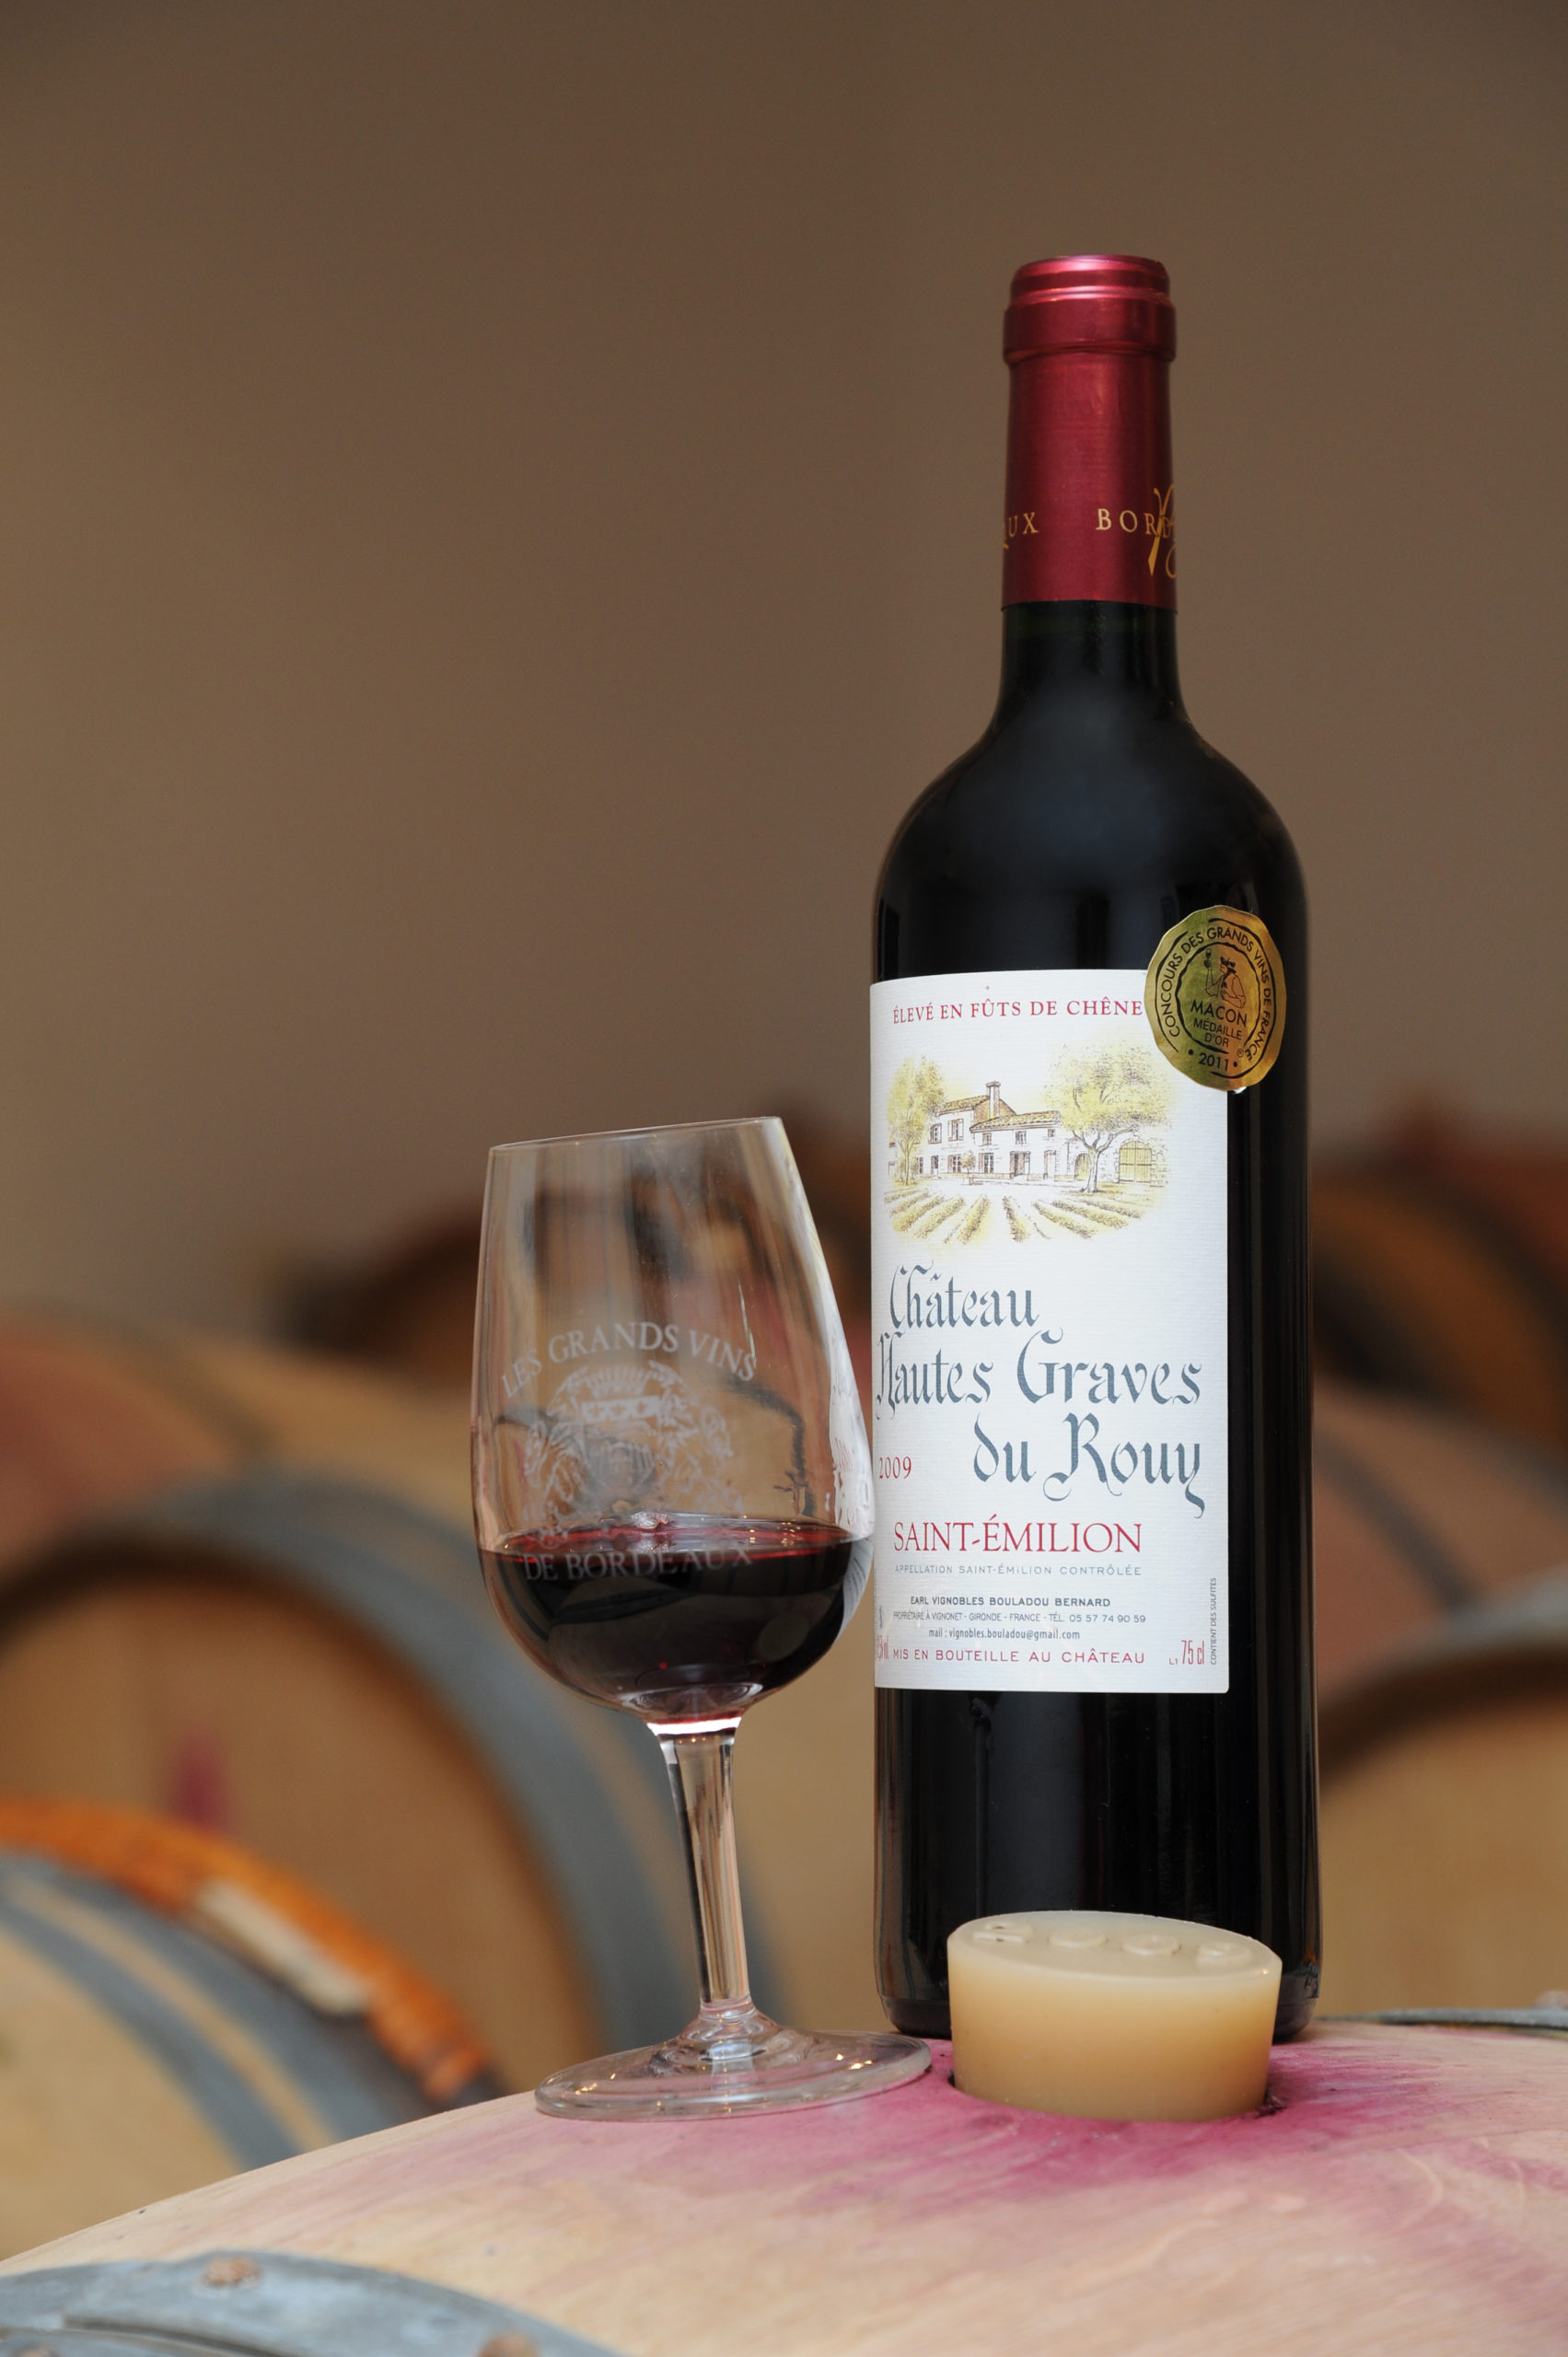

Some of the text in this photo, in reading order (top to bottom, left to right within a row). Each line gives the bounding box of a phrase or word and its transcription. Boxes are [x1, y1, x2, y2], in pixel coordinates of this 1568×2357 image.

[1161, 926, 1272, 1061] CONCOURS DES GRANDS VINS DE FRANCE
[893, 996, 1143, 1024] ÉLEVÉ EN FÛTS DE CHÊNE
[1191, 999, 1248, 1028] MACON
[1193, 1017, 1242, 1040] MÉDAILLE
[1204, 1032, 1229, 1047] D'OR
[1198, 1052, 1229, 1071] 2011
[889, 1260, 1040, 1329] Château
[501, 1321, 757, 1399] LES GRANDS VINS
[876, 1327, 1202, 1420] Hautes Graves
[878, 1457, 912, 1480] 2009
[973, 1412, 1205, 1519] du Rouy
[893, 1514, 1142, 1553] SAINT-ÉMILION
[522, 1545, 754, 1582] DE BORDEAUX
[894, 1562, 1142, 1576] APPELLATION SAINT-ÉMILION CONTRÔLÉE
[910, 1596, 1111, 1608] EARL VIGNOBLES BOULADOU BERNARD
[932, 1612, 963, 1621] VIGNONET
[969, 1612, 1002, 1621] GIRONDE
[1009, 1613, 1040, 1622] FRANCE
[1069, 1614, 1082, 1622] 05
[1086, 1614, 1098, 1622] 57
[1102, 1614, 1114, 1623] 74
[1117, 1614, 1131, 1623] 90
[1133, 1615, 1146, 1623] 59
[948, 1629, 1081, 1642] vignobles.bouladou@gmail.com
[893, 1647, 1145, 1665] MIS EN BOUTEILLE AU CHÂTEAU
[1181, 1640, 1194, 1665] 75
